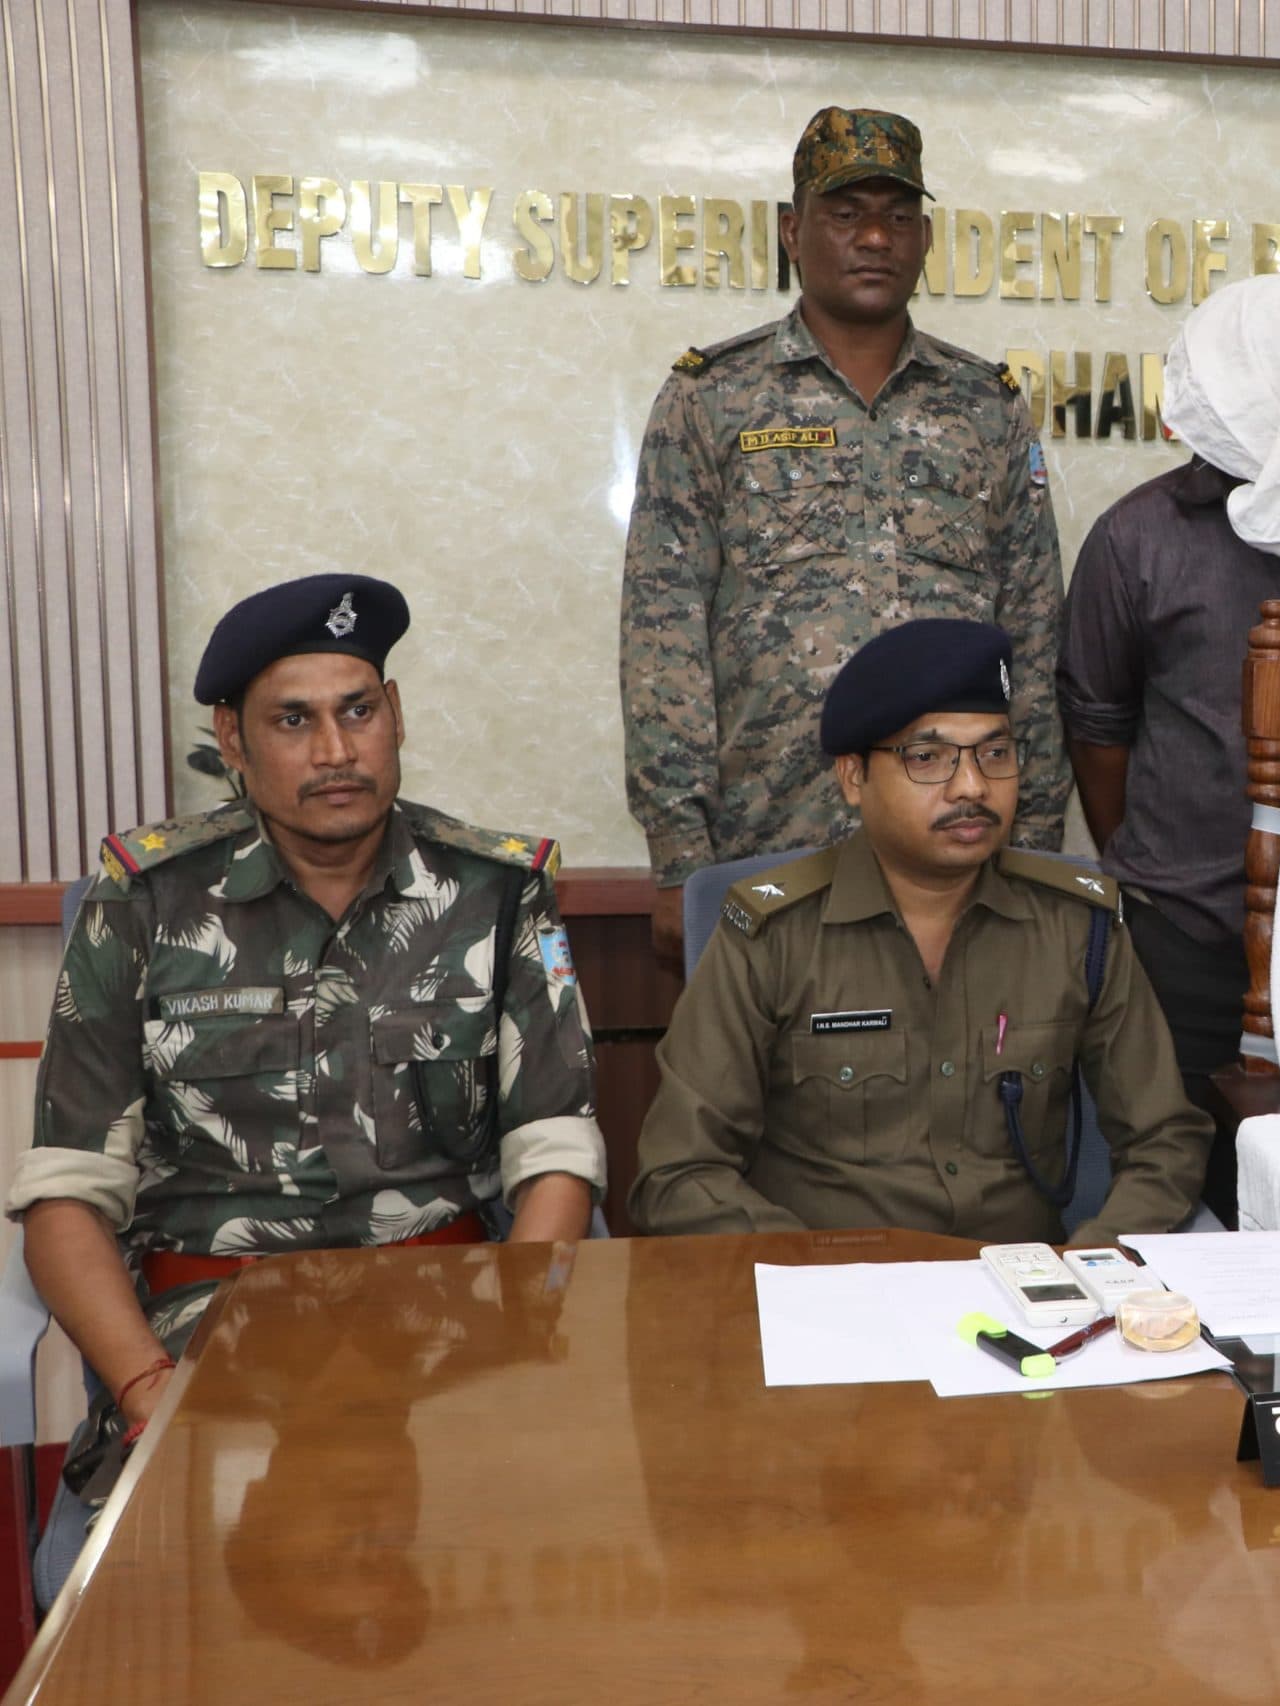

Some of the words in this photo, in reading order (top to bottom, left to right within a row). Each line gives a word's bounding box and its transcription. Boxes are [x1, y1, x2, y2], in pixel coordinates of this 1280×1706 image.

[198, 171, 494, 279] DEPUTY
[513, 188, 1123, 303] SUPERINDENT
[1145, 217, 1230, 305] OF
[800, 432, 819, 442] ALI
[166, 994, 219, 1015] VIKASH
[223, 992, 273, 1010] KUMAR
